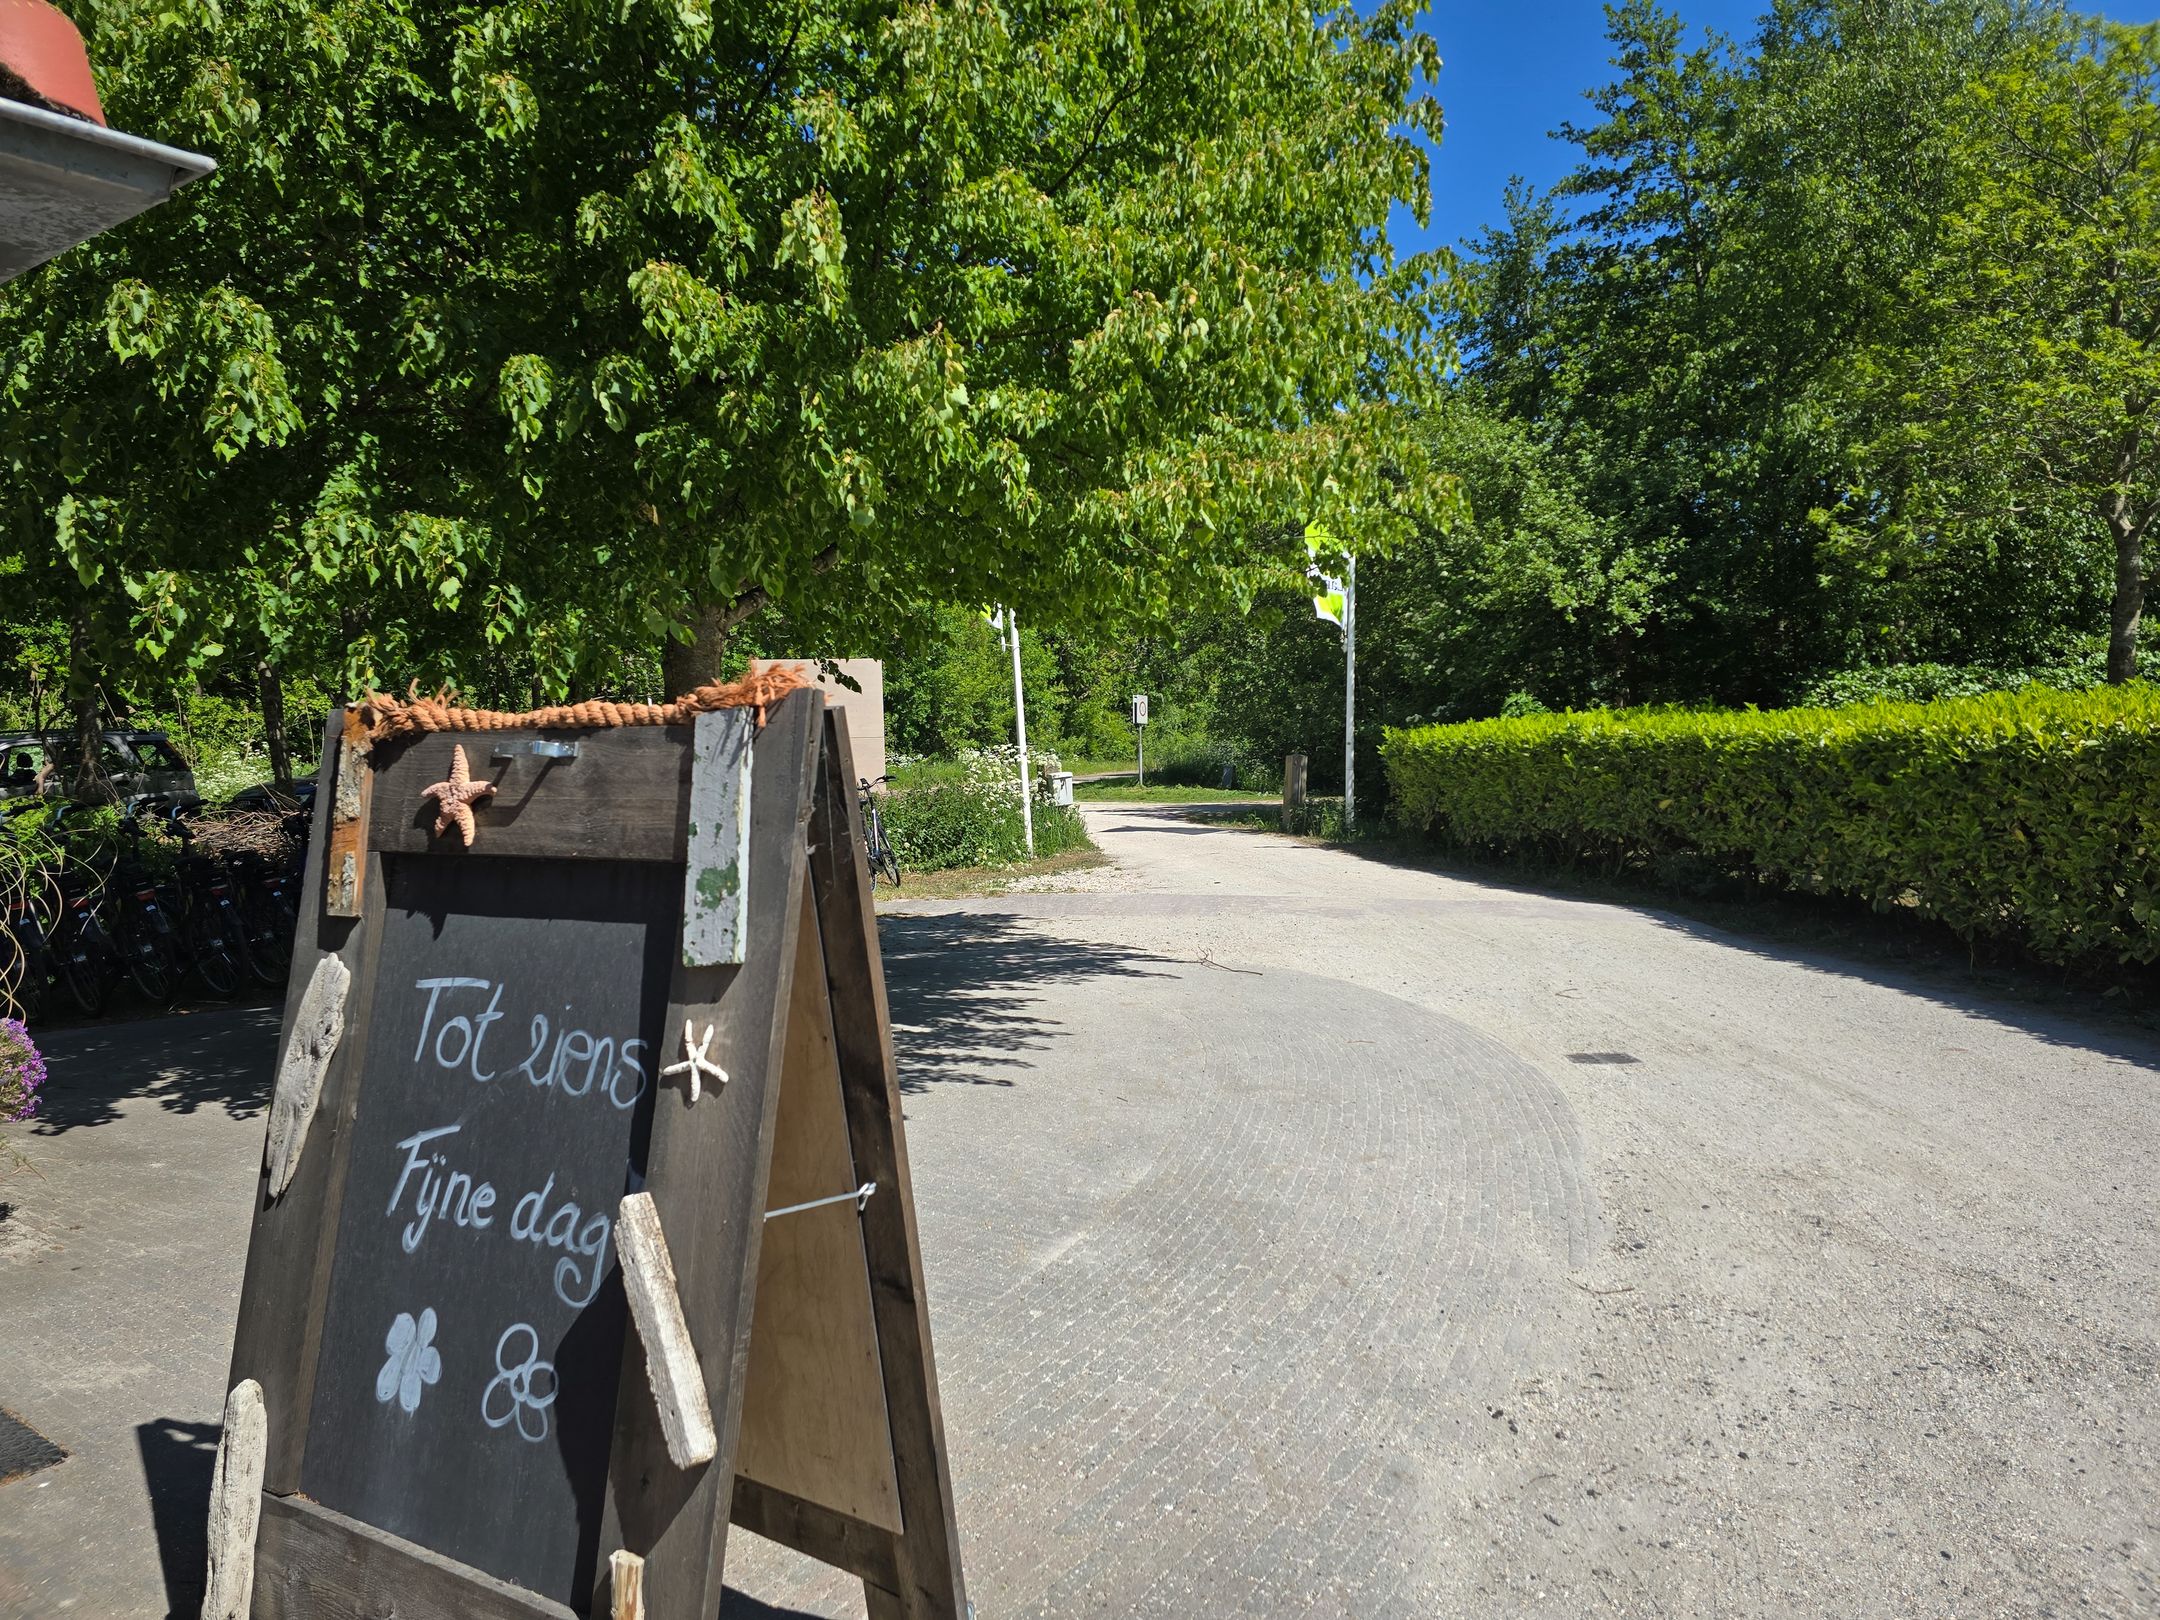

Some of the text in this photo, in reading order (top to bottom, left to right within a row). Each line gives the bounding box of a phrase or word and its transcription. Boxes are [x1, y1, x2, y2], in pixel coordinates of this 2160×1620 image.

[415, 976, 648, 1110] Tot ziens
[510, 1171, 610, 1308] dag
